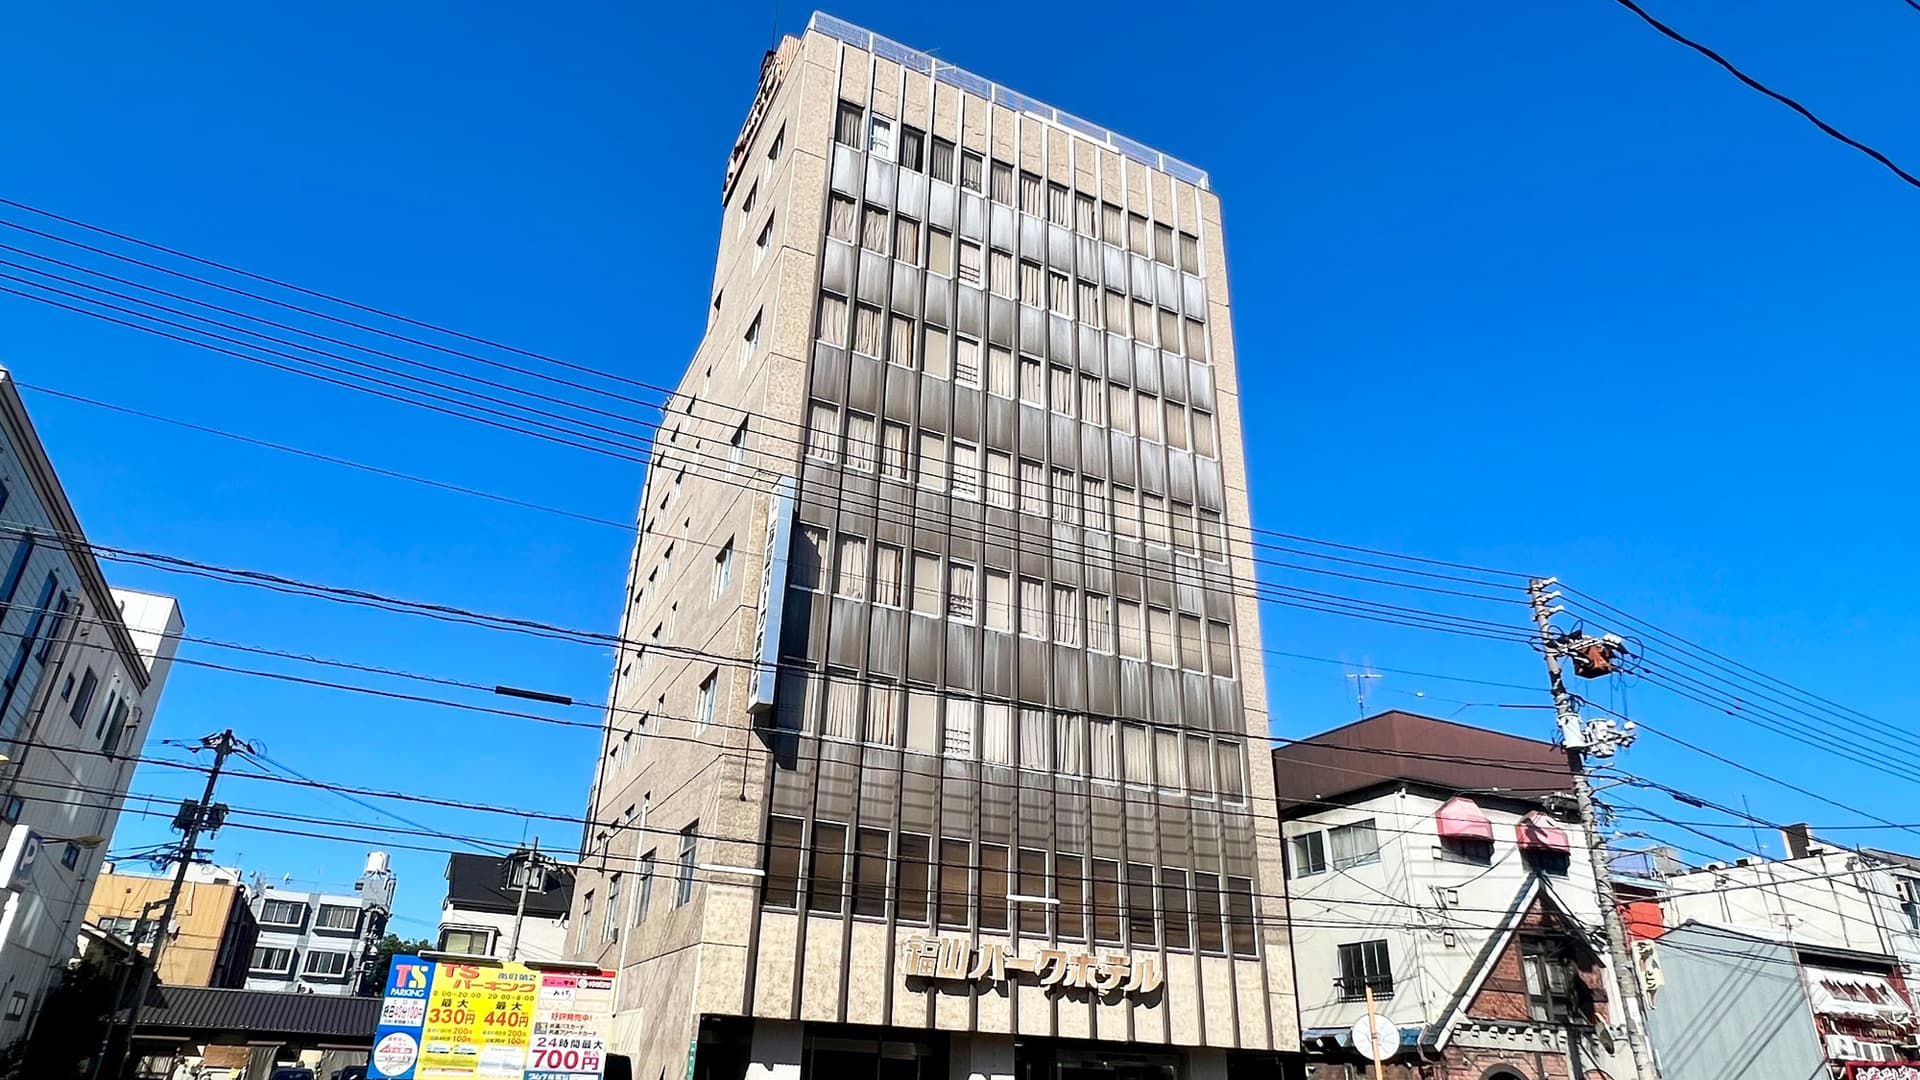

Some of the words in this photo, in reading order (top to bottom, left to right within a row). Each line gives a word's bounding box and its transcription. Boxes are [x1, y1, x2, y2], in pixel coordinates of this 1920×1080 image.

[441, 962, 480, 979] TS
[904, 936, 1163, 993] 福山パークホテル
[396, 964, 429, 988] TS
[391, 988, 424, 997] PARKING
[453, 979, 536, 993] パーキング
[428, 1008, 476, 1025] 330円
[484, 1011, 529, 1027] 440円
[532, 1049, 600, 1070] 700円
